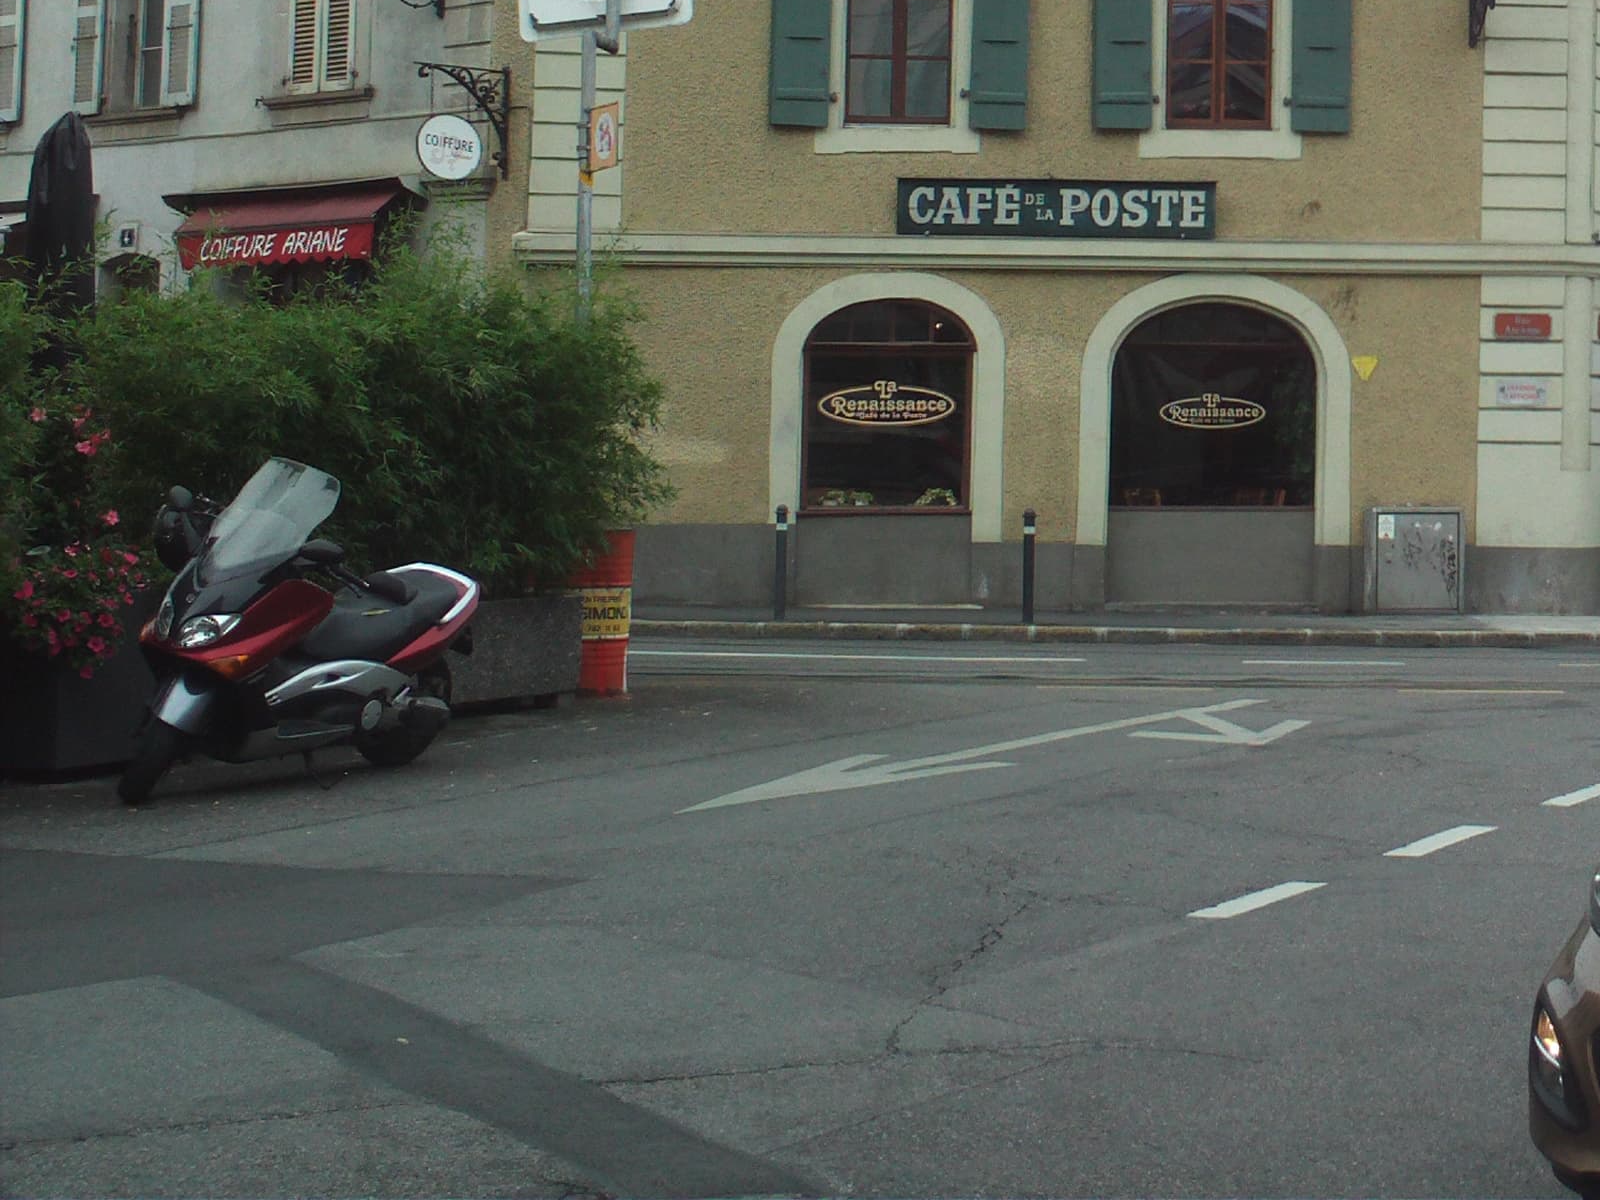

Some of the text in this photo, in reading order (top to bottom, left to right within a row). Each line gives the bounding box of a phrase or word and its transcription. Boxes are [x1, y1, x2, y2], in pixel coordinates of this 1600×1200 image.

[424, 133, 474, 153] COIFFURE
[908, 184, 1207, 228] CAFÉ DE LA POSTE
[200, 227, 349, 262] COIFFURE ARIANE
[874, 380, 898, 399] La
[830, 396, 947, 417] Renaissance
[1202, 393, 1221, 408] La
[1169, 405, 1260, 422] Renaissance
